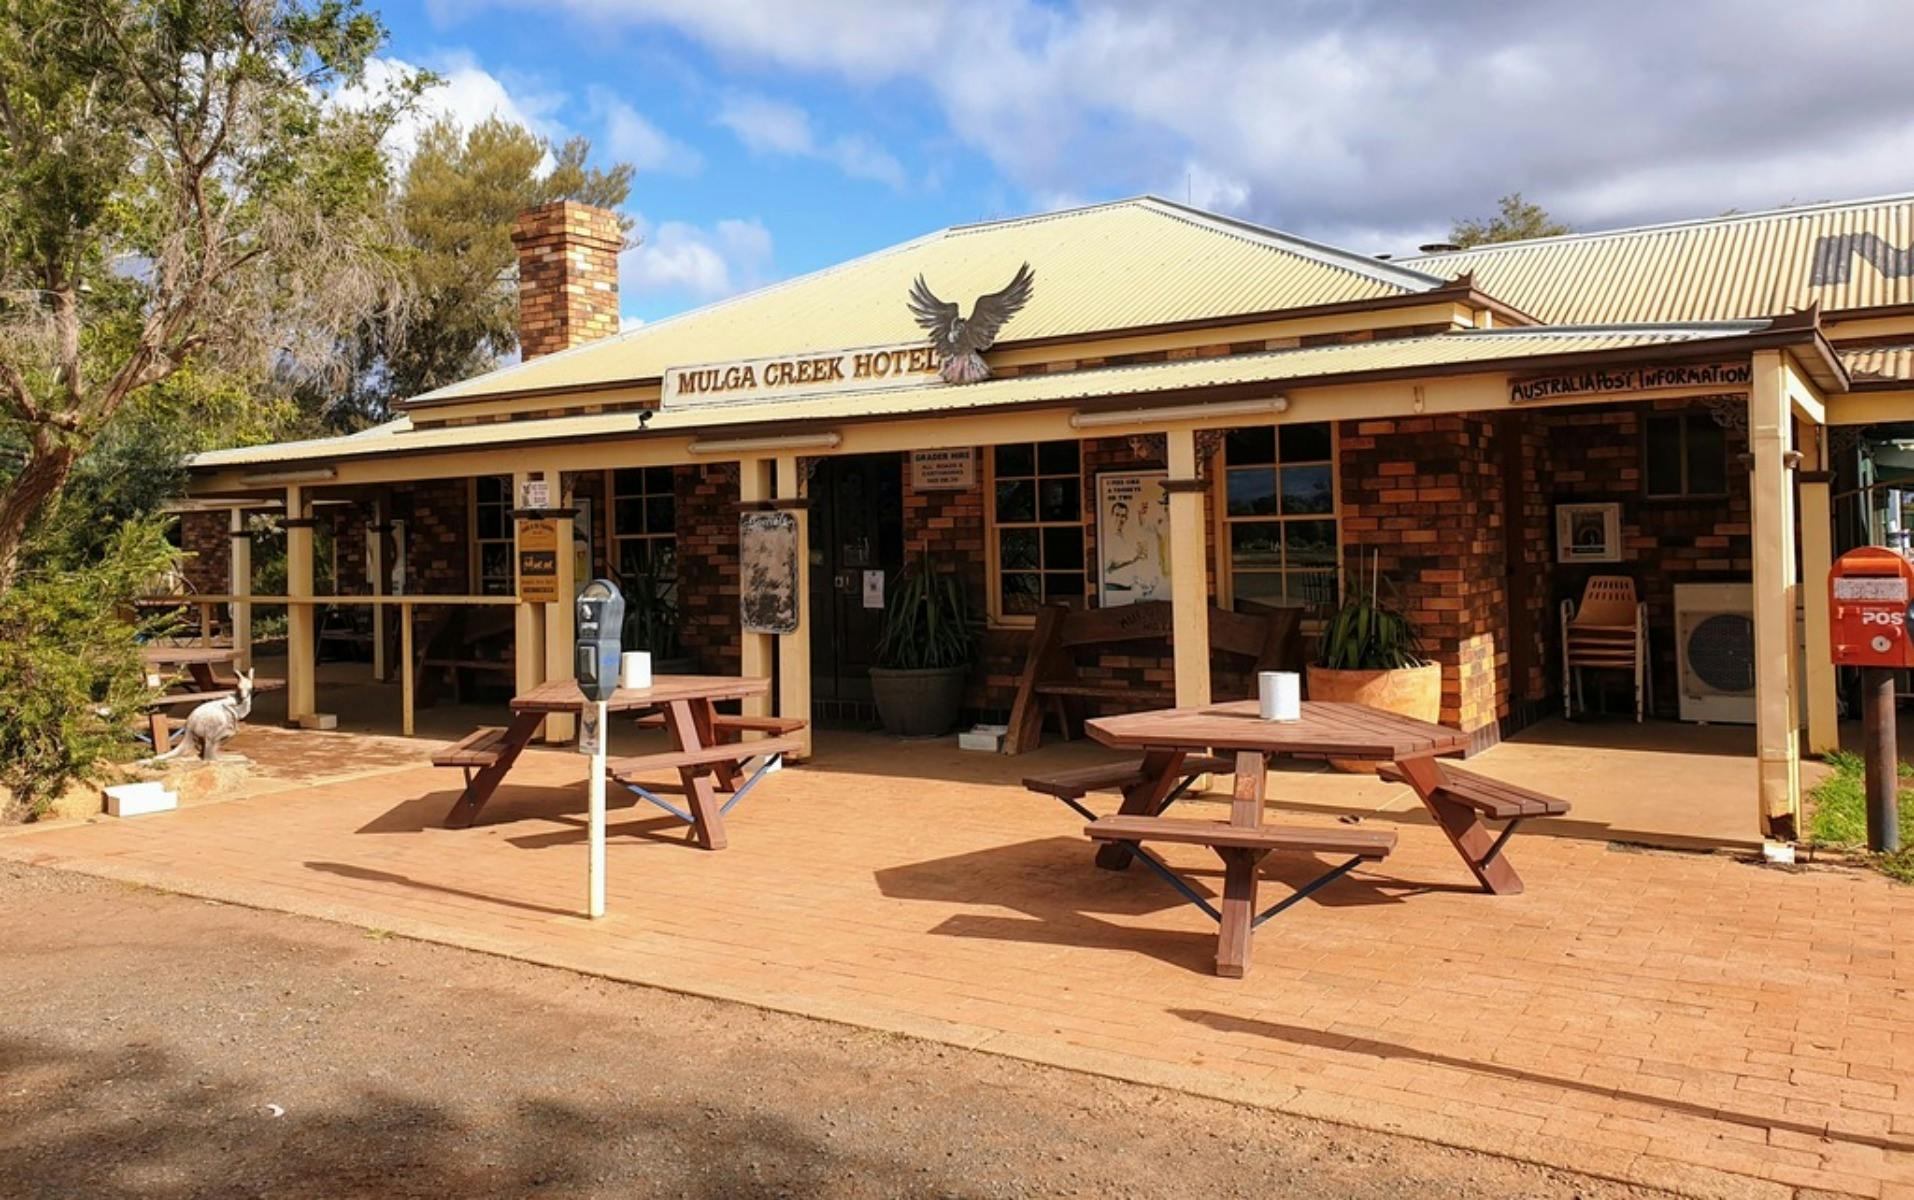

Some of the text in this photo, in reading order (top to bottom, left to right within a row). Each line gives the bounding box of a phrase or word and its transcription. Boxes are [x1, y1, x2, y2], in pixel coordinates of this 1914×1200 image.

[677, 347, 942, 394] MULGA CREEK HOTEL
[1511, 371, 1595, 401] AUSTRALIA
[1638, 363, 1750, 389] INFORMATION
[915, 452, 948, 461] GRADER
[1862, 612, 1906, 625] POS
